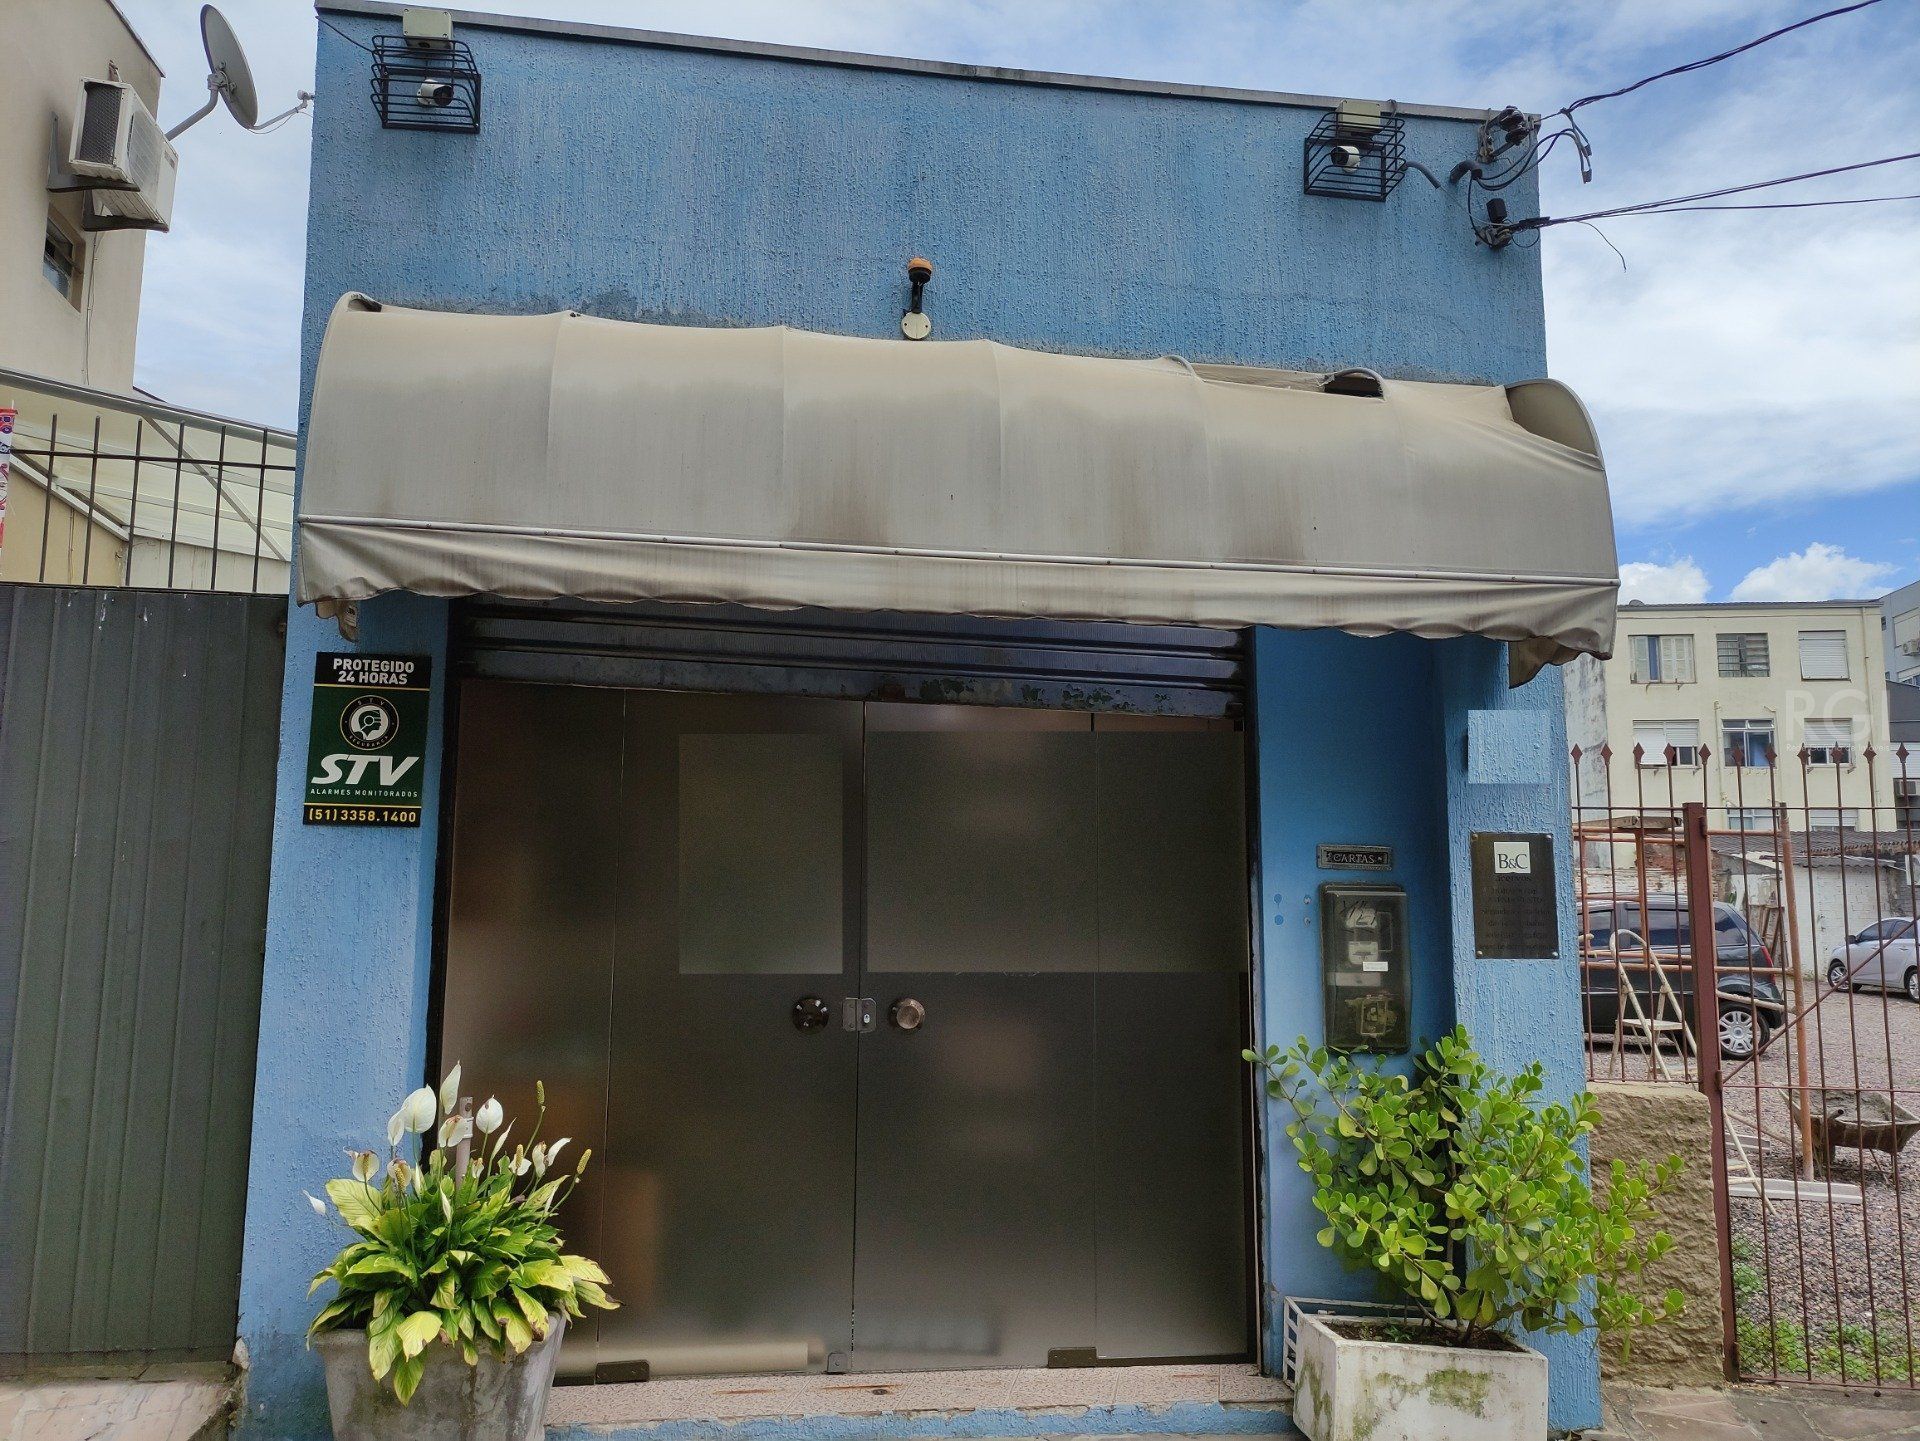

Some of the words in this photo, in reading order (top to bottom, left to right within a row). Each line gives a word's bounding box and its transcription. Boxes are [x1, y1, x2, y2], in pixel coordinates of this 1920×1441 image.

[333, 658, 415, 673] PROTEGIDO
[338, 670, 355, 683] 24
[358, 672, 408, 685] HORAS
[311, 753, 420, 786] STV
[310, 788, 351, 796] ALARMES
[354, 789, 418, 798] MONITORADOS
[1333, 853, 1375, 864] CARTAS
[1498, 853, 1528, 869] B&C
